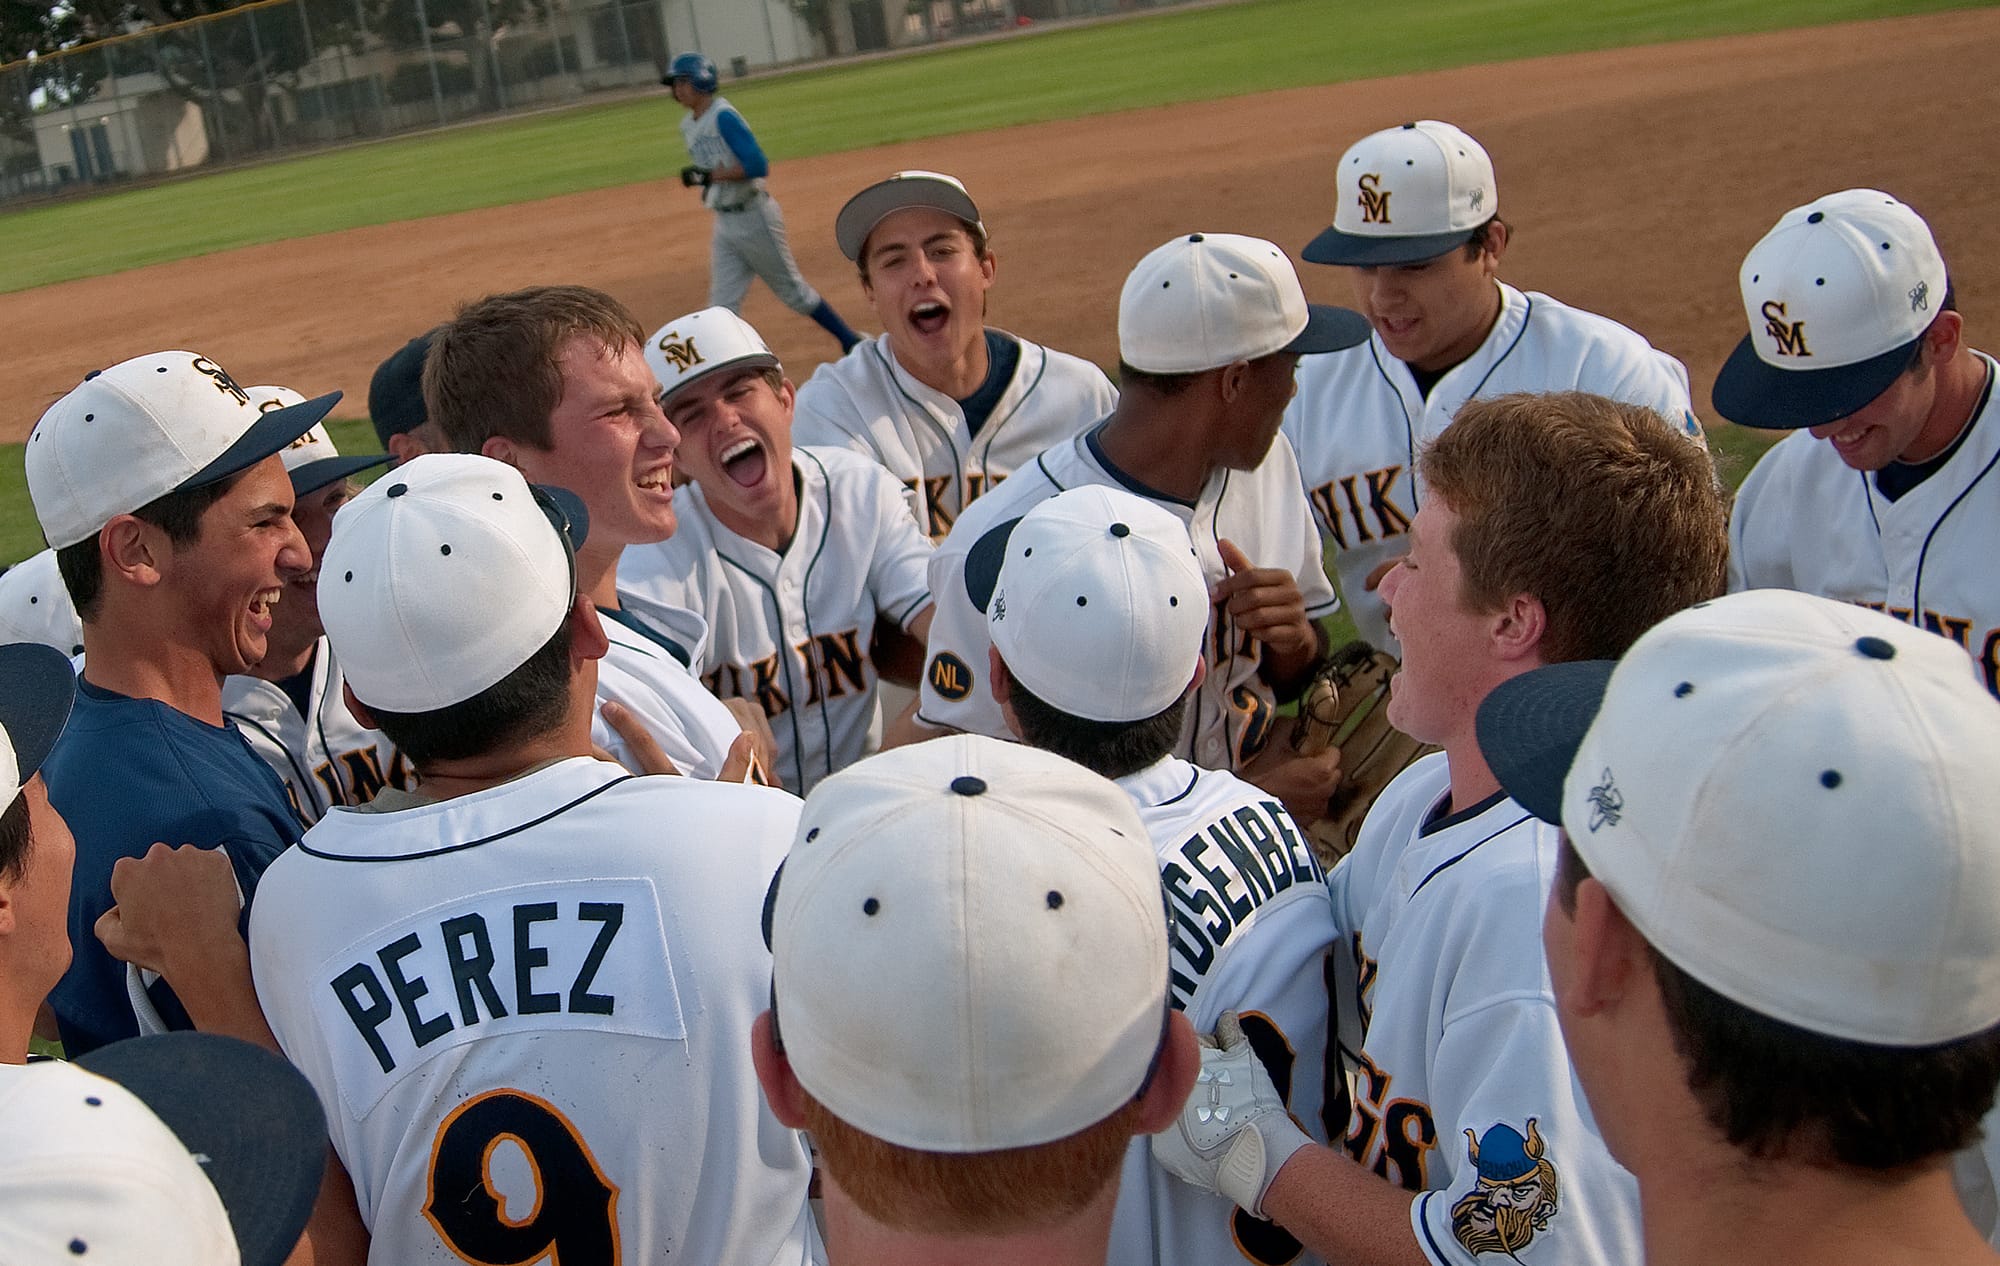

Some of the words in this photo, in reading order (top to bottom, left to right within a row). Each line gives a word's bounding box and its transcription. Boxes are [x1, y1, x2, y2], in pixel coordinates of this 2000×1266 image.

[1358, 173, 1392, 225] SM
[658, 330, 706, 375] SM
[1761, 300, 1813, 357] SM
[1310, 464, 1412, 550] VIK
[935, 660, 965, 692] NL
[330, 901, 624, 1074] PEREZ
[420, 1087, 621, 1266] 9
